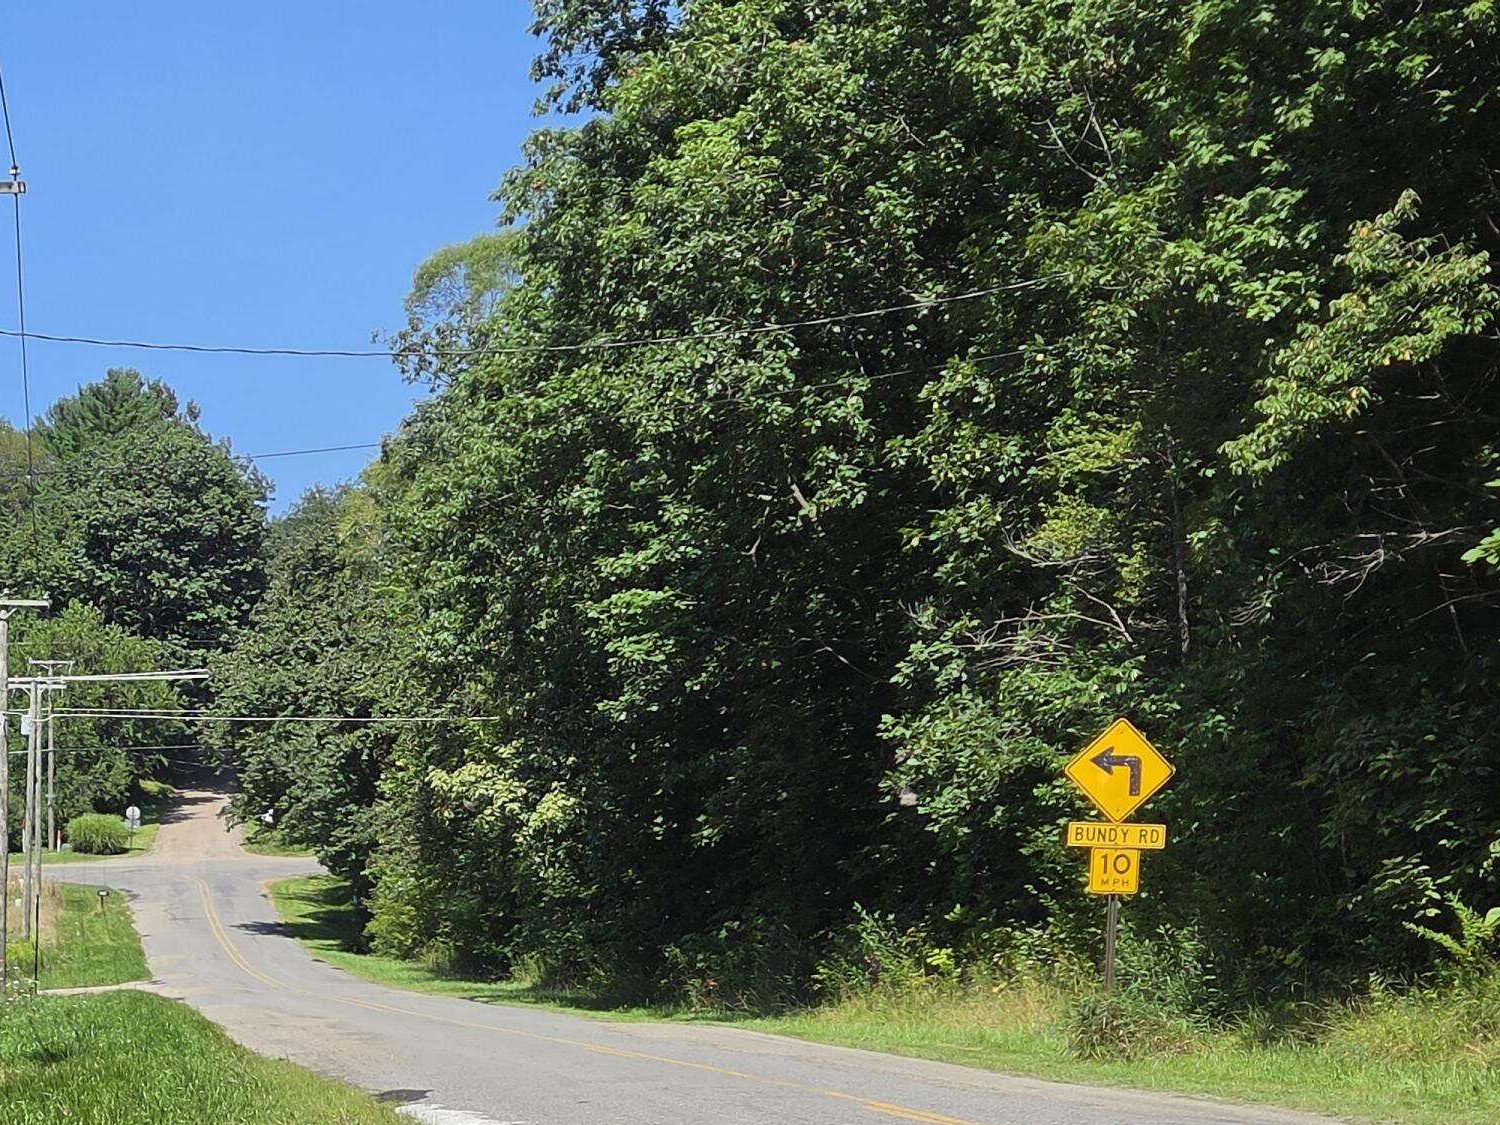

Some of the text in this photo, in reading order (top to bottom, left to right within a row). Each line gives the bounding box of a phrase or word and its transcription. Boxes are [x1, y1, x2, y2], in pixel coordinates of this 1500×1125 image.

[1075, 827, 1159, 843] BUNDY RD
[1101, 854, 1131, 874] 10
[1101, 879, 1129, 887] MPH
